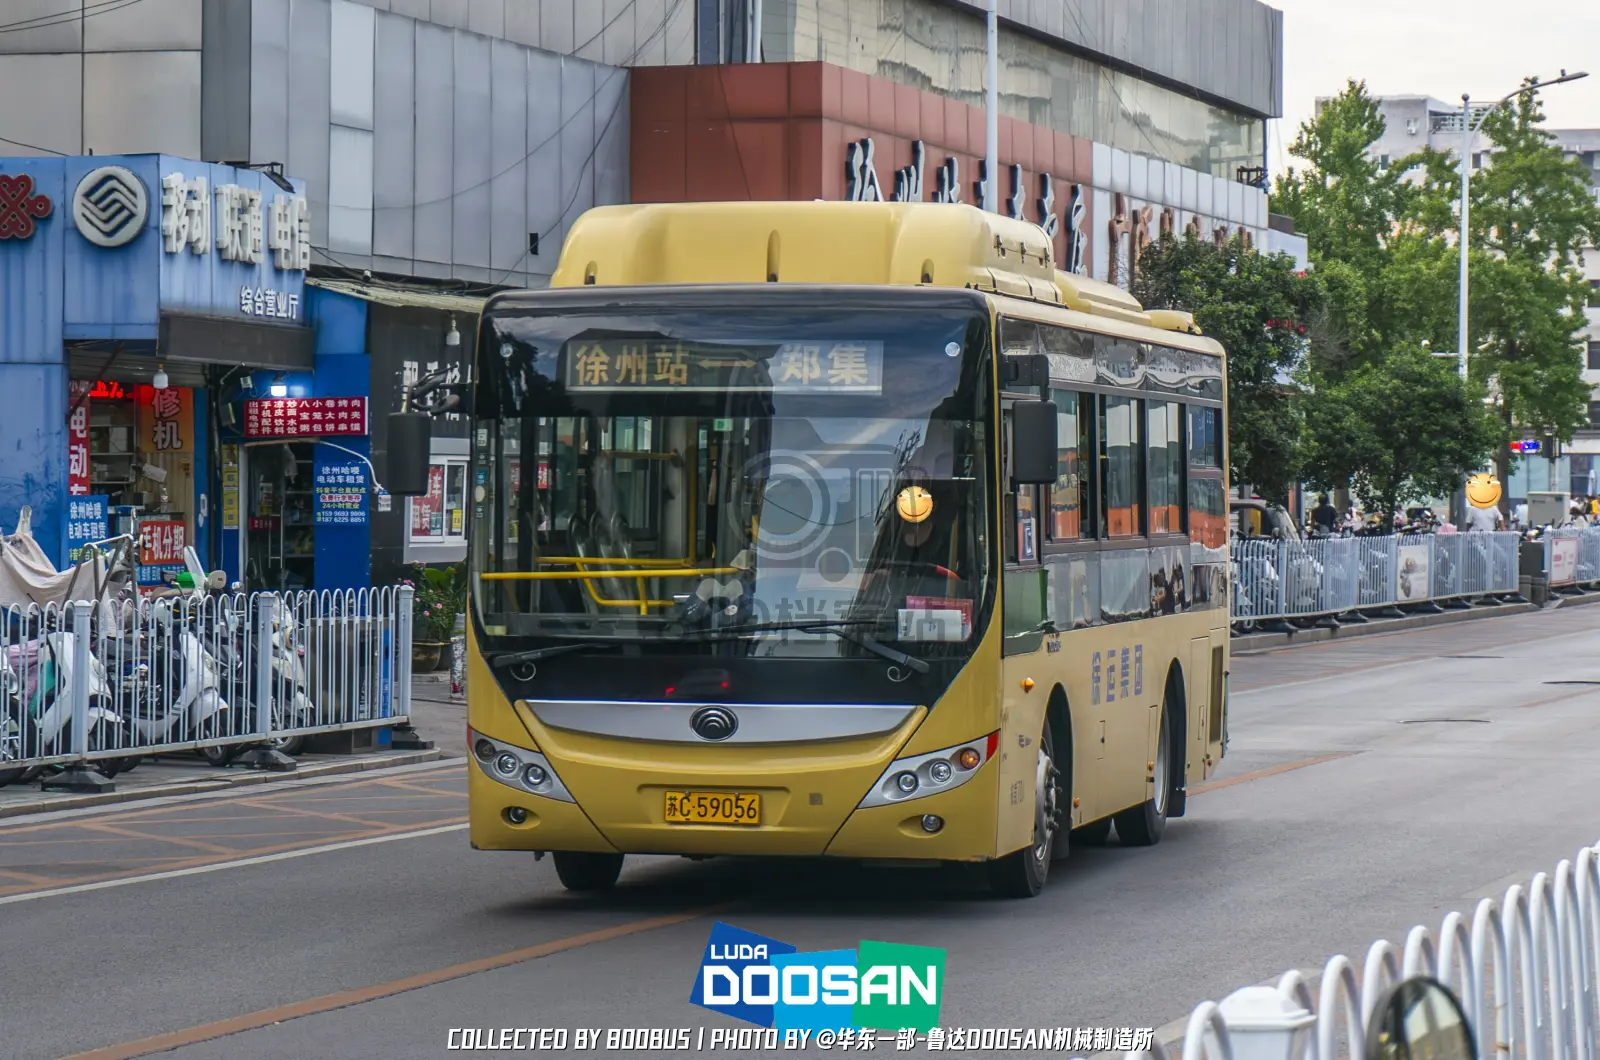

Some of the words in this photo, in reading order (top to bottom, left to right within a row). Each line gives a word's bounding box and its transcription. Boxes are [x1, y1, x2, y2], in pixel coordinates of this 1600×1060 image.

[162, 172, 210, 254] 移动
[268, 194, 311, 271] 电信
[241, 285, 299, 319] 综合营业厅
[575, 344, 689, 385] 徐州站
[780, 343, 869, 384] 郑集
